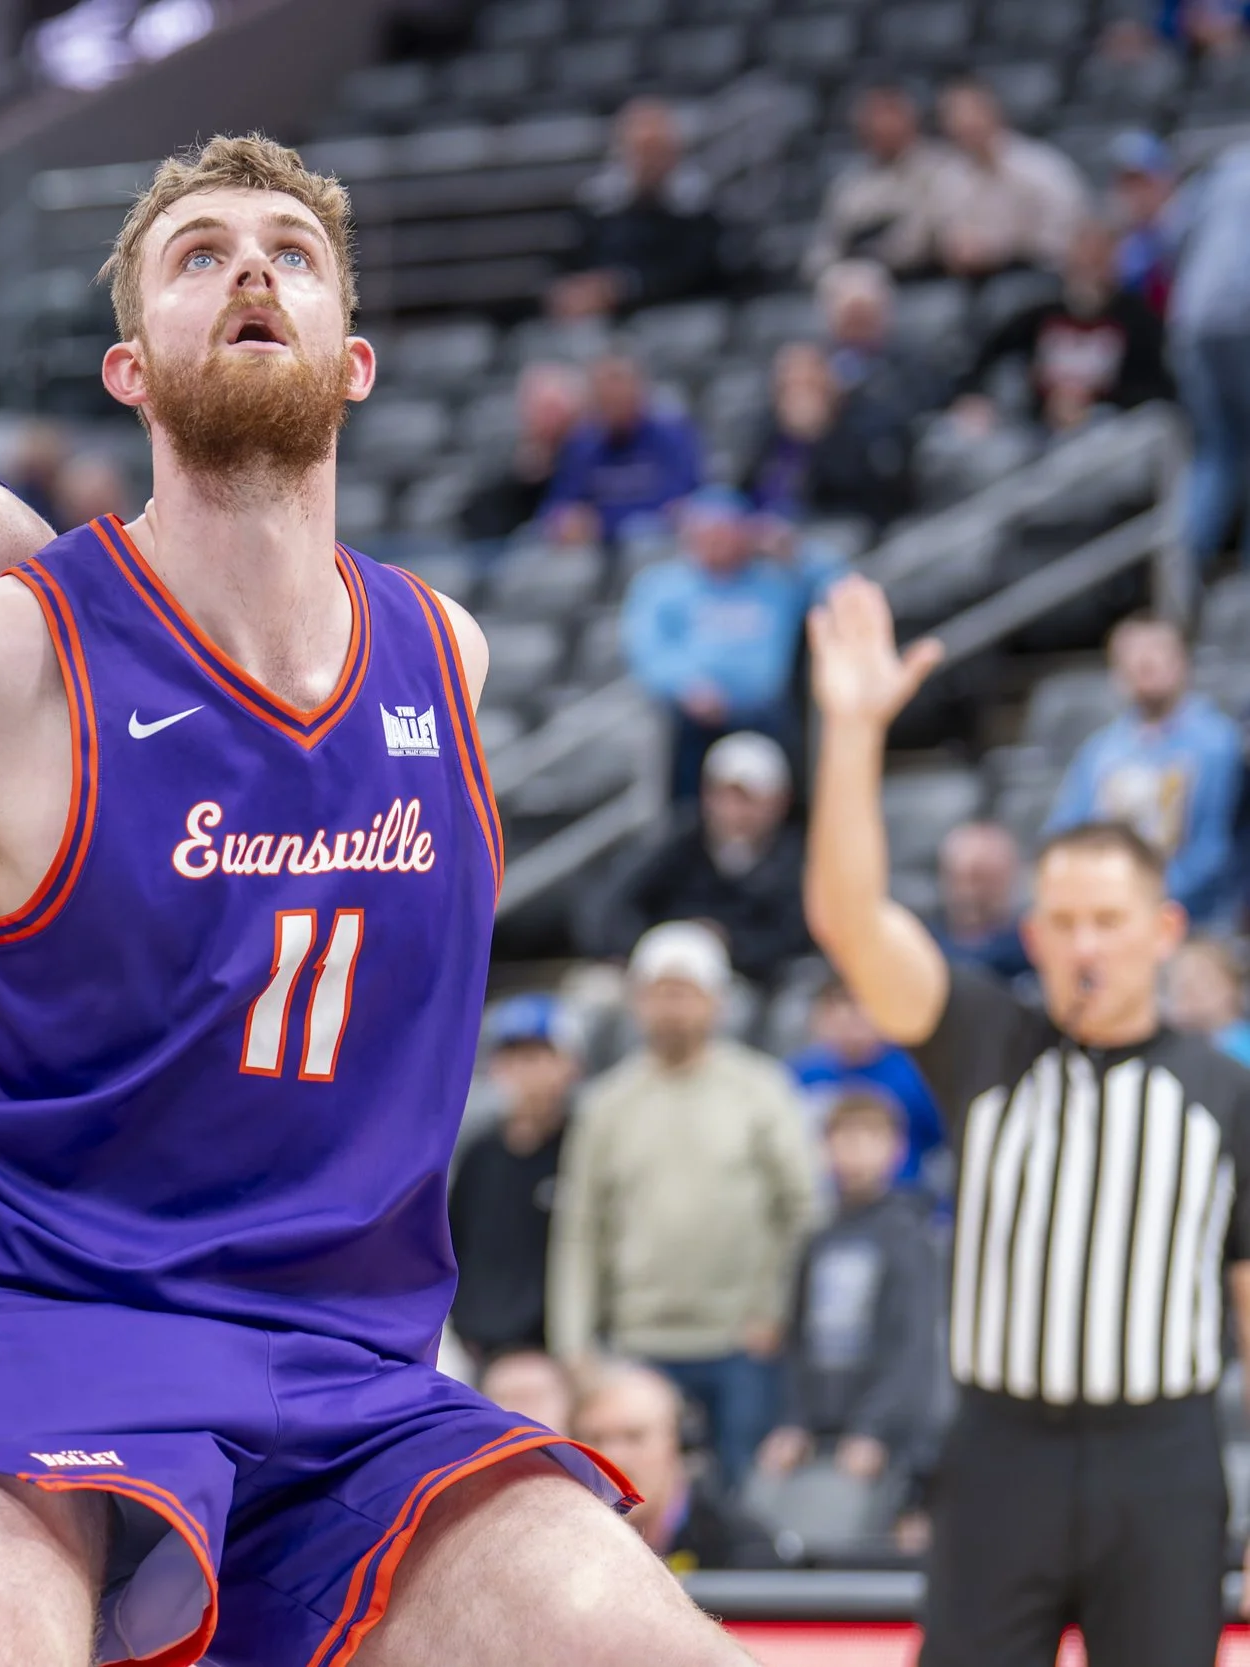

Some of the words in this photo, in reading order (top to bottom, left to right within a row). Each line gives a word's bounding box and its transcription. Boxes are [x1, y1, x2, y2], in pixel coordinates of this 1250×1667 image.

[380, 702, 440, 749] VALLEY
[172, 798, 435, 879] Evansville
[239, 908, 364, 1082] 11
[30, 1450, 124, 1467] VALLEY
